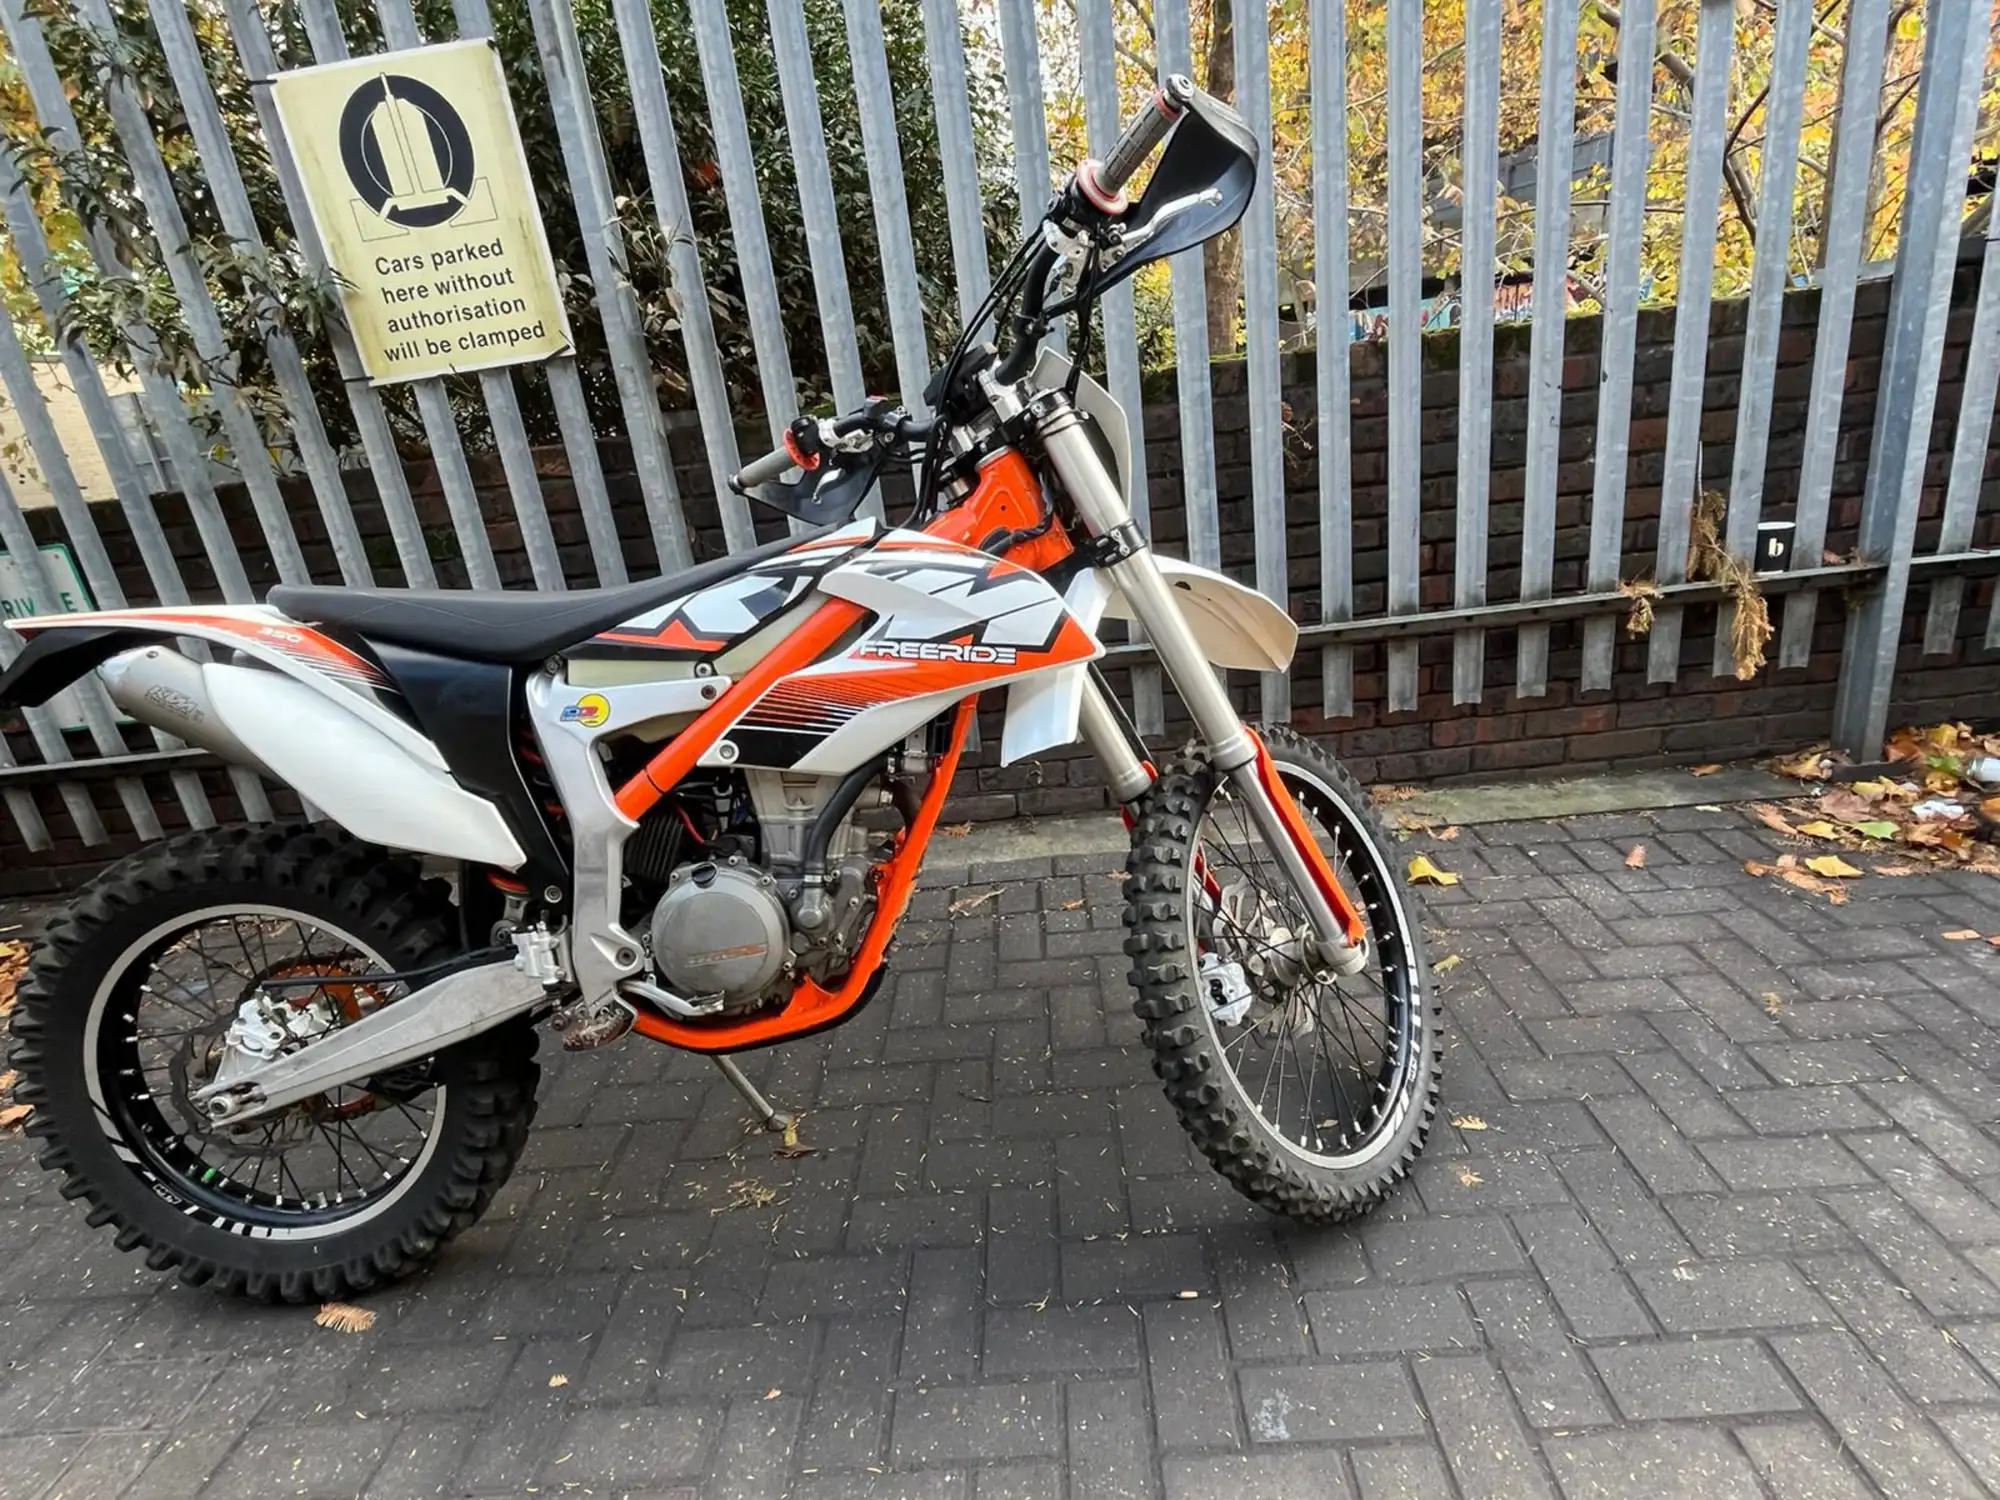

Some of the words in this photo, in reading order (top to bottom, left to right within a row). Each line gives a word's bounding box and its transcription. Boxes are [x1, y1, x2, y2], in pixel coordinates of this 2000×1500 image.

[375, 254, 425, 276] Cars
[430, 237, 504, 271] parked
[381, 283, 430, 305] here
[434, 267, 515, 296] without
[387, 297, 527, 334] authorisation
[384, 340, 421, 363] will
[425, 338, 452, 356] be
[458, 319, 546, 351] clamped
[859, 640, 1017, 665] FREERIDE
